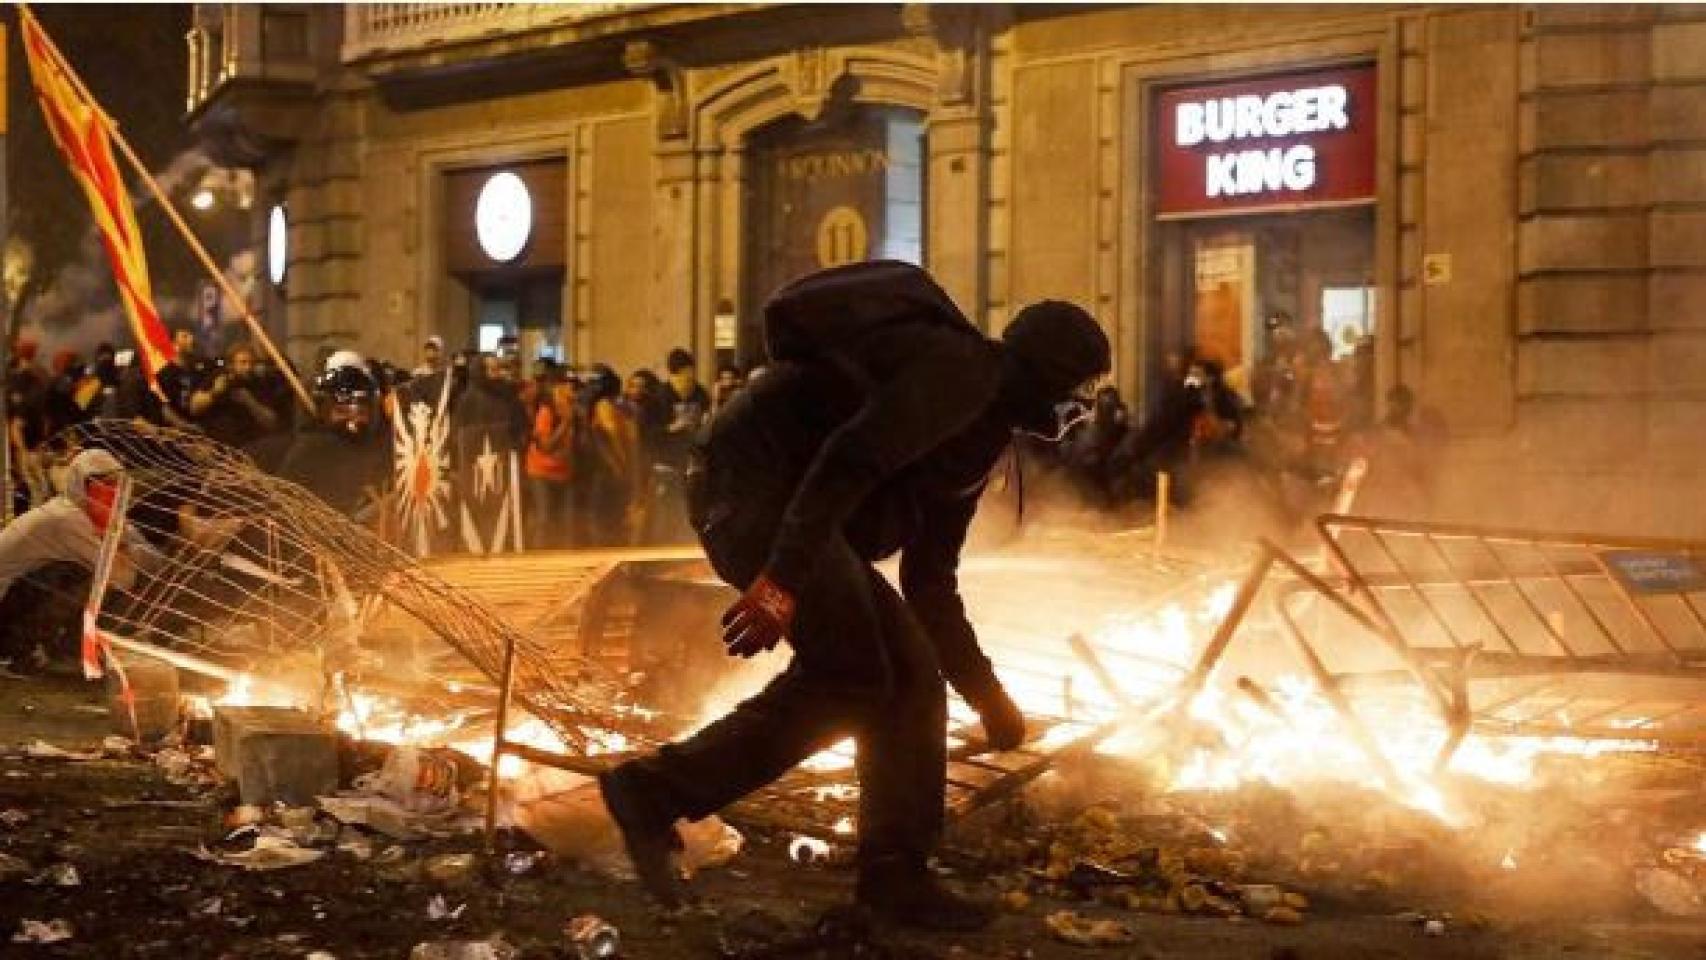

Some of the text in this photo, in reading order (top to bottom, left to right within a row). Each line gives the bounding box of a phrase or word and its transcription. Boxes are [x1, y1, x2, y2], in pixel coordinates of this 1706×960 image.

[1176, 85, 1348, 146] BURGER
[1205, 145, 1316, 197] KING
[827, 222, 856, 264] 11
